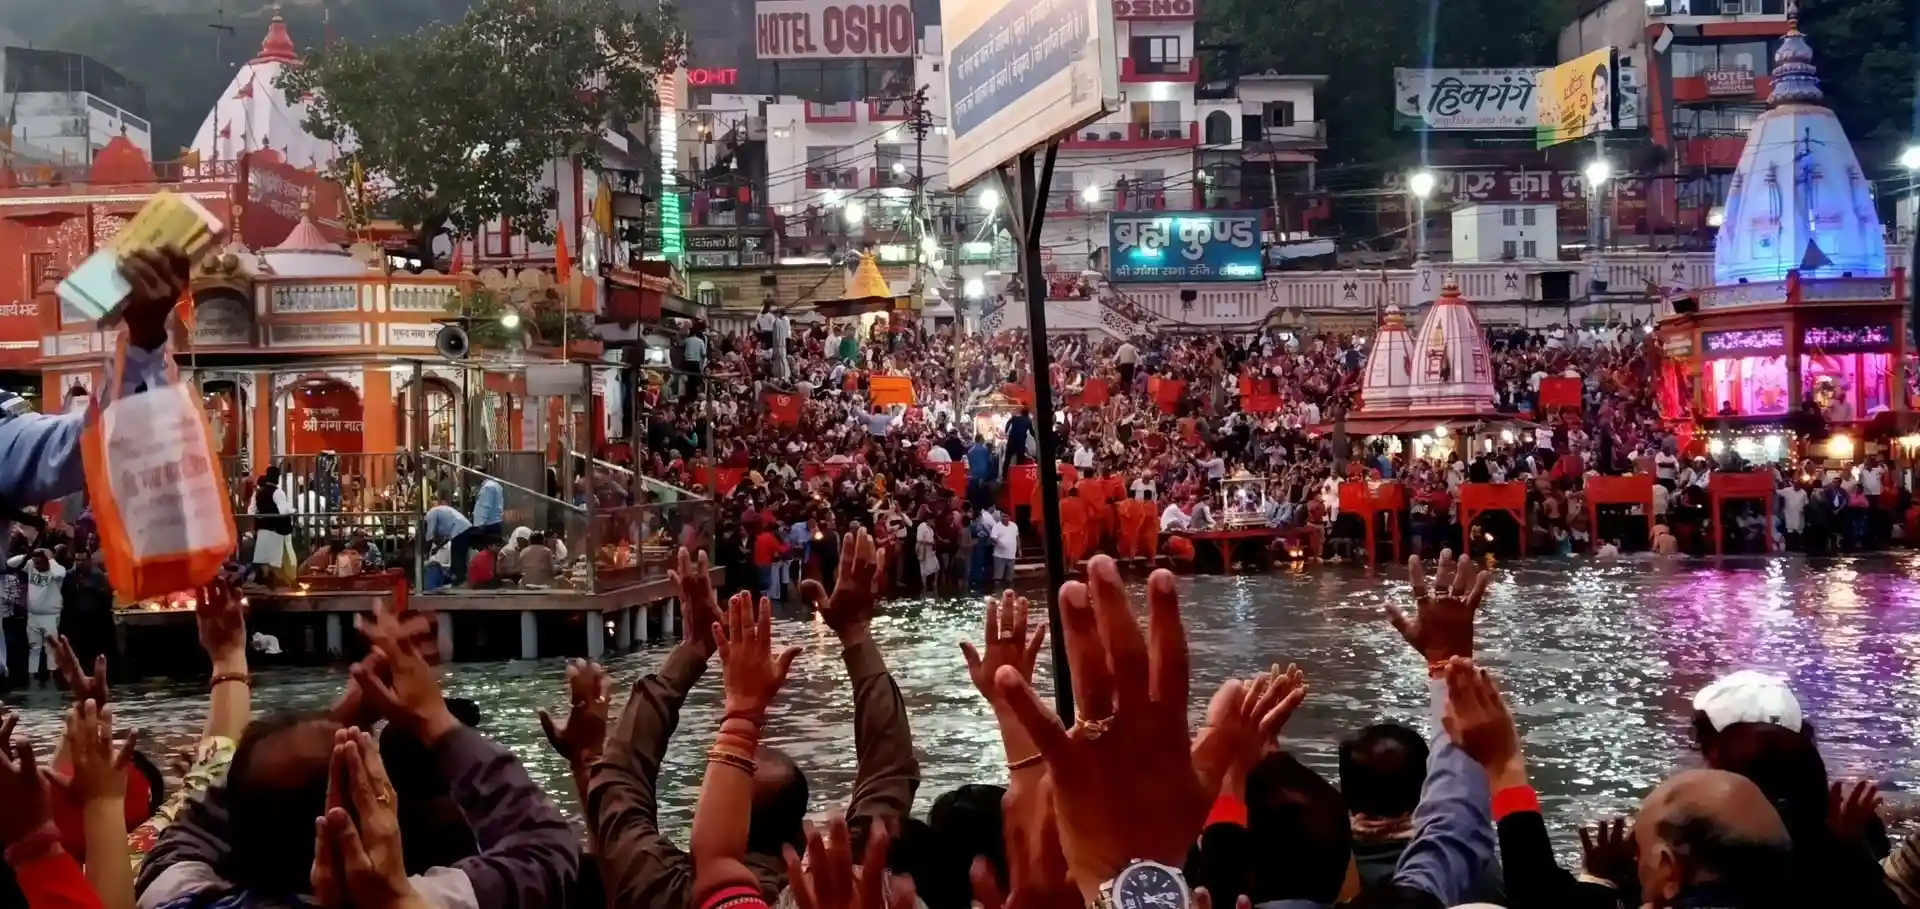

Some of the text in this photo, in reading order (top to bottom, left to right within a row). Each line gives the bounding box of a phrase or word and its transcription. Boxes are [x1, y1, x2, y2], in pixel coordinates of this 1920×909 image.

[1115, 0, 1191, 15] OSHO
[757, 4, 910, 55] HOTEL OSHO
[1706, 71, 1754, 81] HOTEL
[1426, 76, 1536, 116] हिमगंगे
[1503, 170, 1551, 198] का
[1177, 217, 1257, 260] कुण्ड
[1116, 264, 1131, 276] श्री
[1133, 264, 1159, 276] गंगा
[302, 416, 318, 431] श्री
